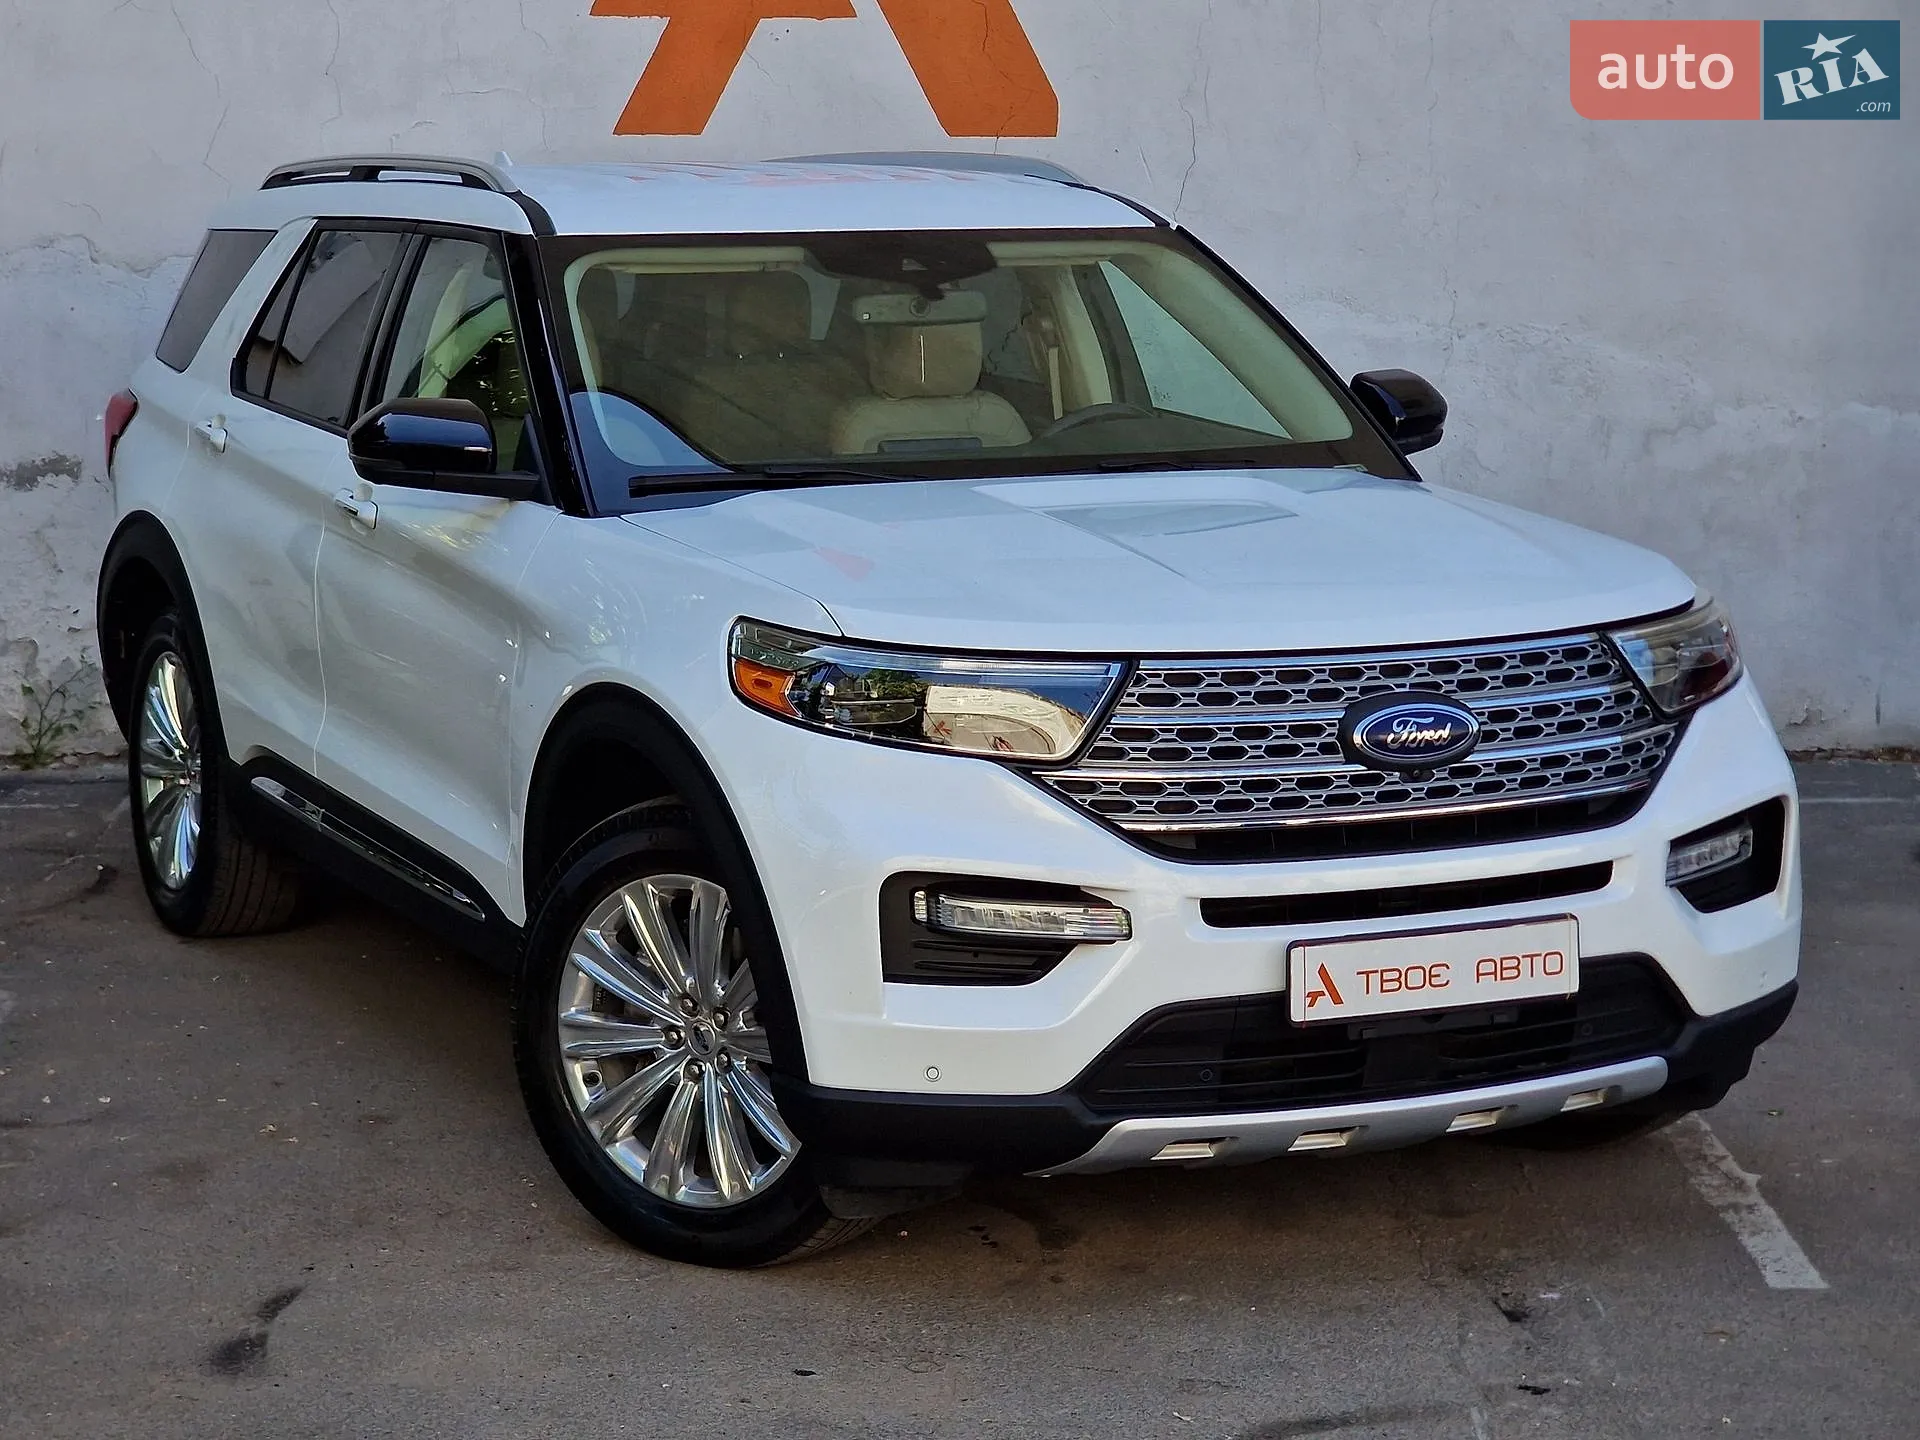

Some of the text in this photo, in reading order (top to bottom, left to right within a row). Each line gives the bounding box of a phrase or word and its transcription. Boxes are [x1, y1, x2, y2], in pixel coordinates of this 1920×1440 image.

[1386, 716, 1452, 749] Ford
[1356, 963, 1450, 995] ТВОЄ
[1475, 950, 1564, 984] АВТО
